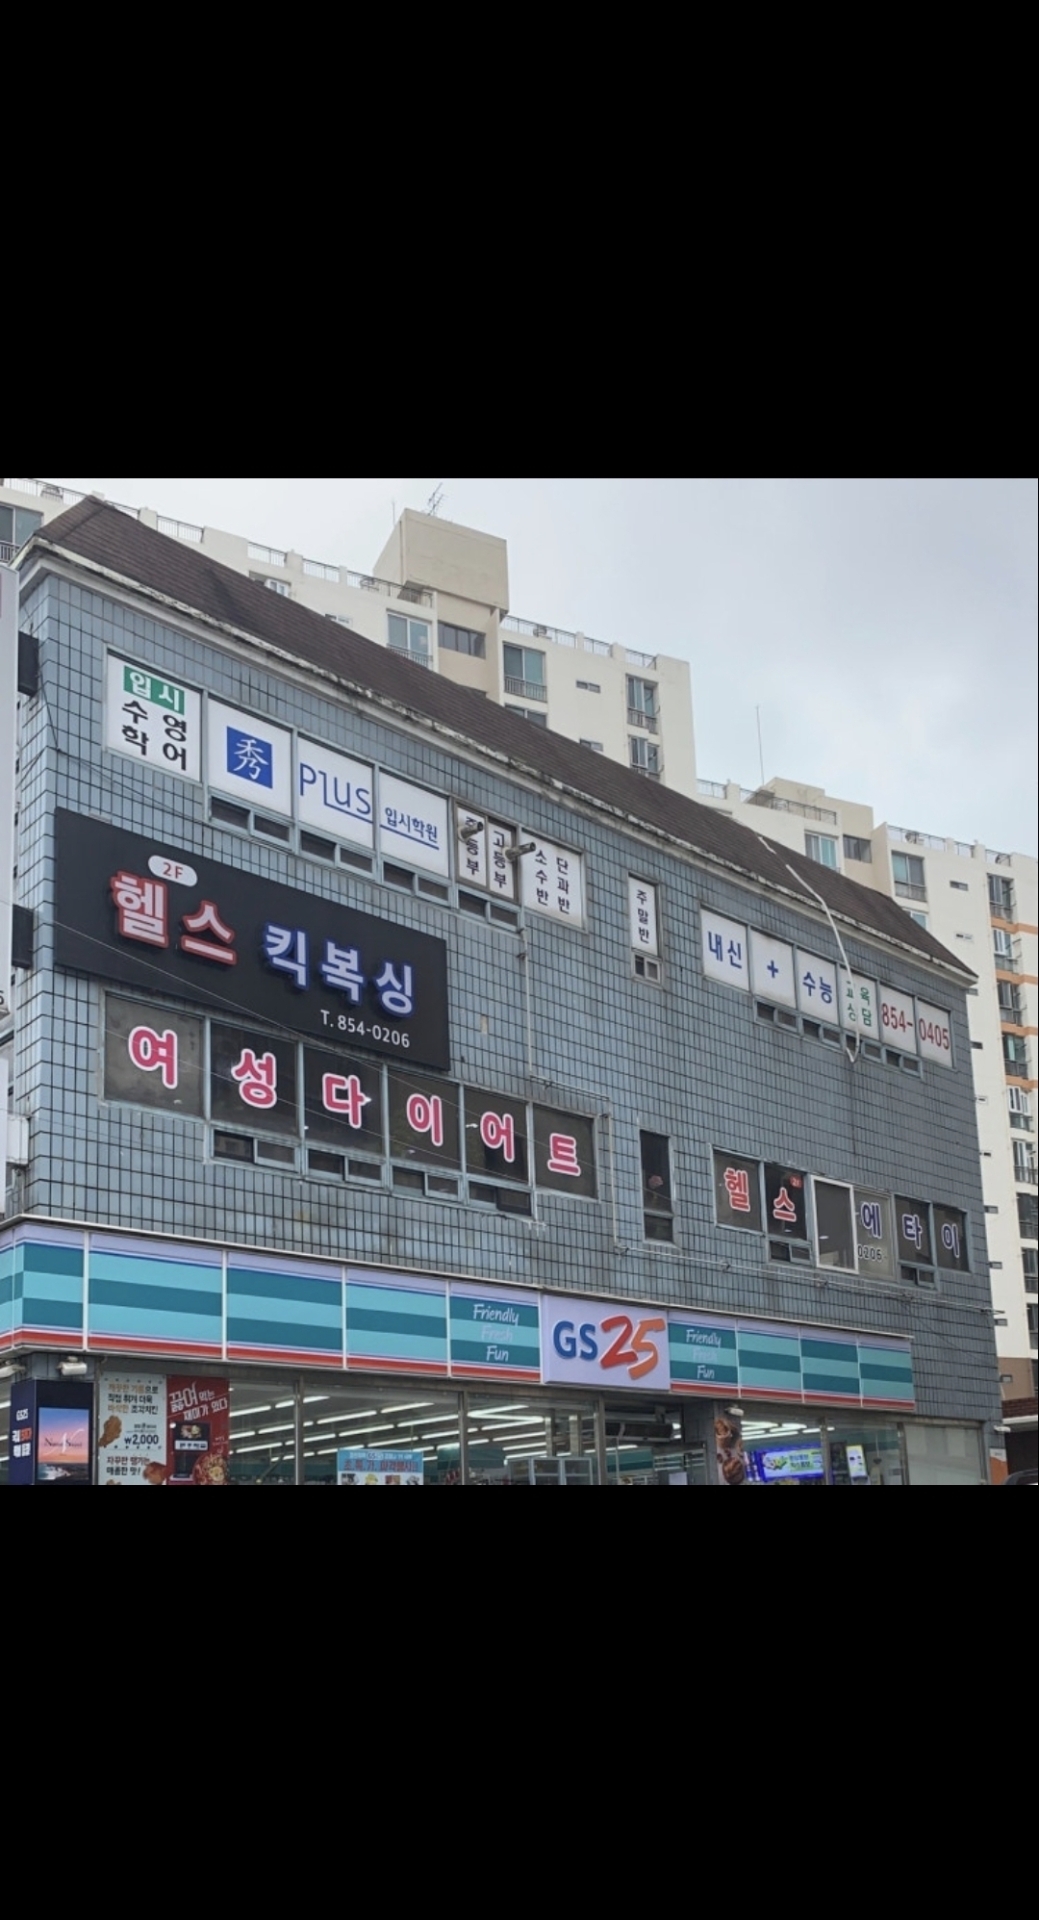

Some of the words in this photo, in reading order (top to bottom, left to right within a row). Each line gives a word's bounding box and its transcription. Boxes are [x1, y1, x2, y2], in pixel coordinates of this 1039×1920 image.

[129, 671, 181, 712] 입시
[122, 700, 149, 756] 수학
[162, 714, 187, 771] 영어
[233, 738, 269, 780] 秀
[300, 762, 372, 816] Plus
[384, 807, 438, 843] 입시학원
[161, 861, 184, 881] 2F
[492, 830, 507, 888] 고등부
[535, 849, 549, 906] 소수반
[556, 856, 570, 915] 단과반
[636, 889, 650, 944] 주말반
[111, 871, 238, 965] 헬스
[262, 920, 416, 1018] 킥복싱
[708, 931, 742, 969] 내신
[802, 971, 833, 1004] 수능
[320, 1009, 335, 1030] T.
[337, 1015, 411, 1049] 854-0206
[881, 1002, 950, 1051] 854-0405
[724, 1166, 797, 1223] 헬스
[473, 1304, 519, 1326] Friendly
[481, 1325, 512, 1342] Fresh
[686, 1329, 722, 1348] Friendly
[486, 1345, 509, 1362] Fun
[552, 1315, 666, 1381] GS25
[697, 1365, 715, 1379] Fun
